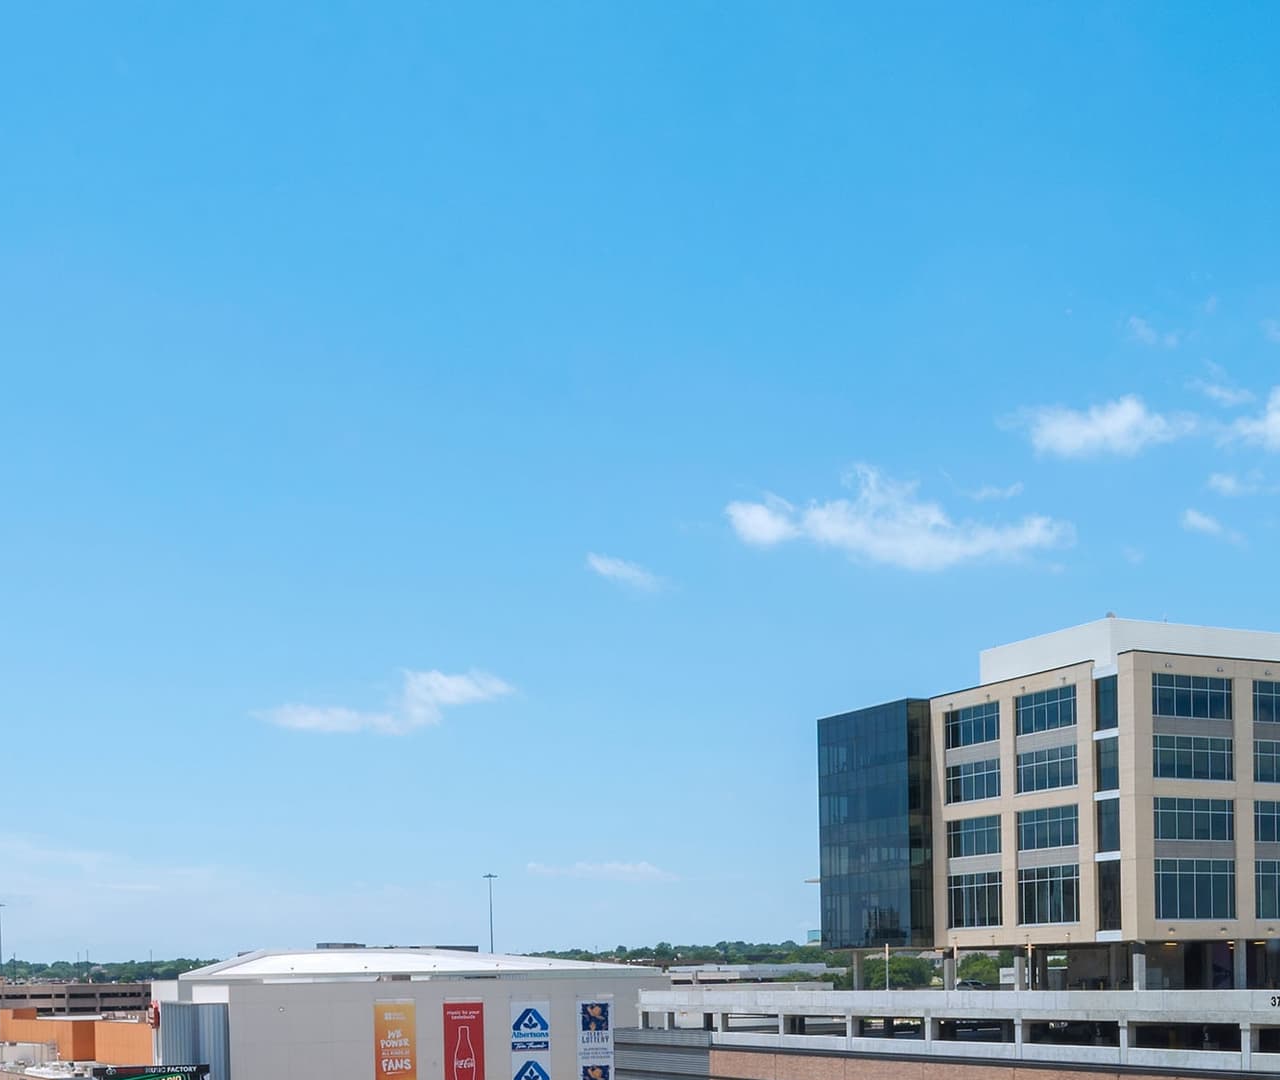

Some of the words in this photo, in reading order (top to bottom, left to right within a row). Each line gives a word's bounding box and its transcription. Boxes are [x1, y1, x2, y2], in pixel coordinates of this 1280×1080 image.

[511, 1031, 549, 1039] Albertsons
[380, 1039, 409, 1049] POWER
[581, 1036, 609, 1044] LOTTERY
[381, 1058, 412, 1072] FANS
